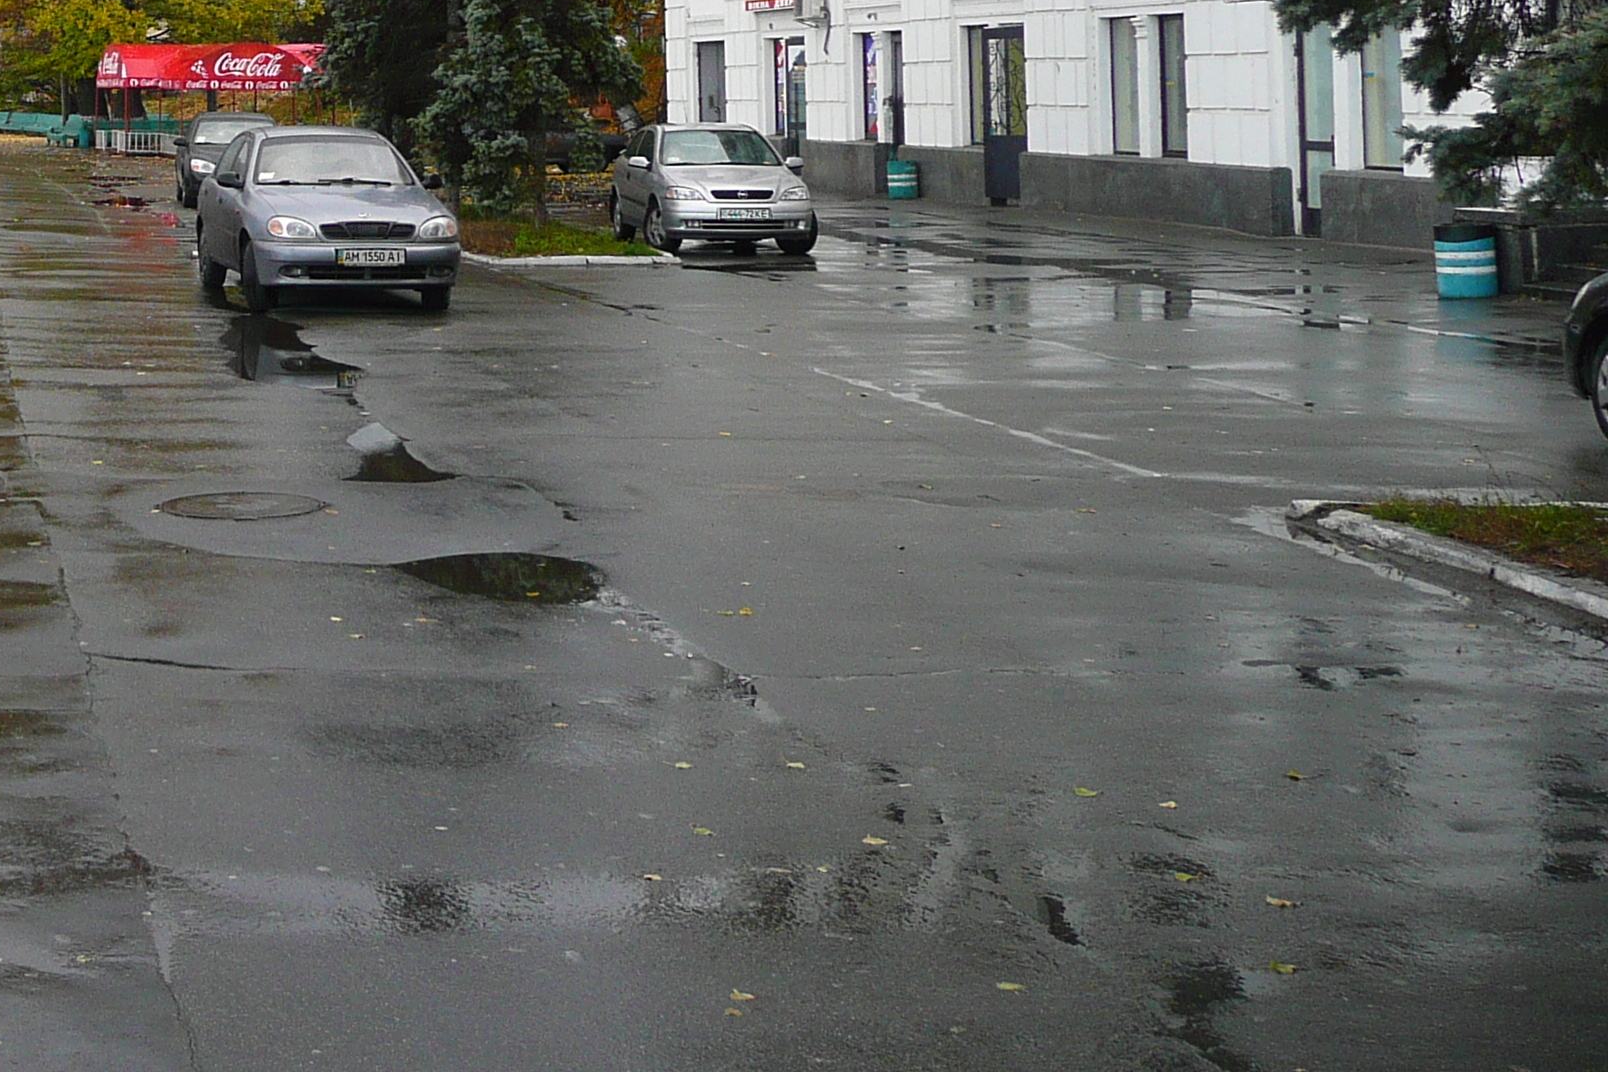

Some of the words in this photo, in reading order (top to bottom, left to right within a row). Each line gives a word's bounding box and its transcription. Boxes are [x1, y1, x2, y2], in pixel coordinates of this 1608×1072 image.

[214, 52, 285, 77] Coca-Cola
[345, 252, 360, 262] AM
[363, 251, 386, 262] 1550
